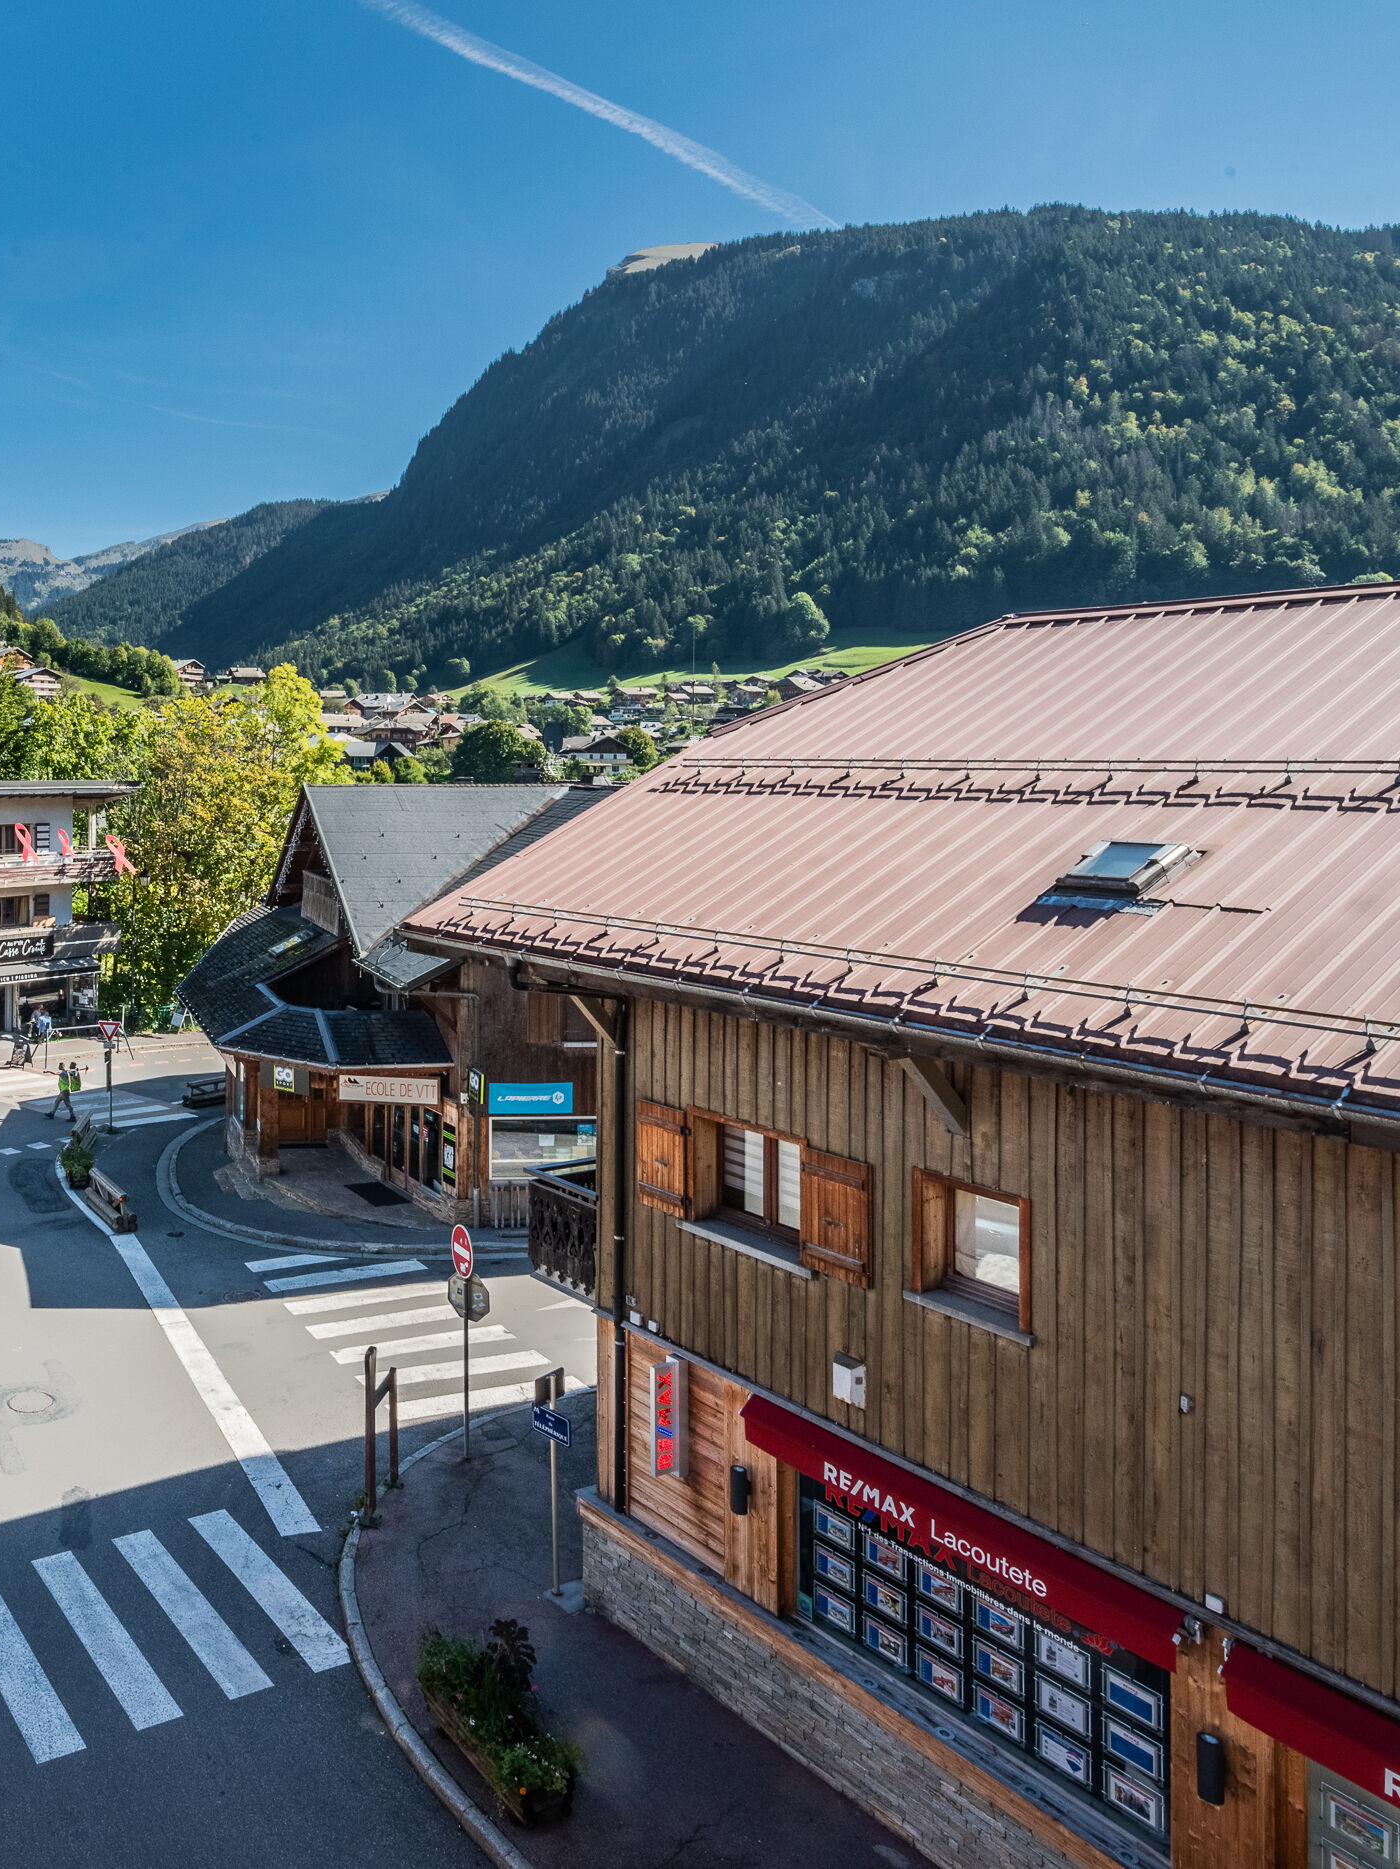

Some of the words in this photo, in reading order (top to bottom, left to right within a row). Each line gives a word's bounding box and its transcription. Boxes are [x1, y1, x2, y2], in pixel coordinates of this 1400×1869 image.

[275, 1066, 293, 1082] GO
[365, 1081, 396, 1098] ECOLE
[399, 1083, 413, 1098] DE
[416, 1085, 437, 1099] VTT
[497, 1094, 551, 1102] LAPIERRE
[657, 1371, 673, 1470] RE/MAX
[823, 1461, 916, 1529] RE/MAX
[930, 1518, 1047, 1598] Lacoutete
[873, 1530, 890, 1546] des
[890, 1538, 945, 1578] Transactions
[945, 1570, 1004, 1608] Immobilières
[1005, 1605, 1031, 1626] dans
[1033, 1618, 1043, 1631] le
[1043, 1627, 1080, 1654] monde
